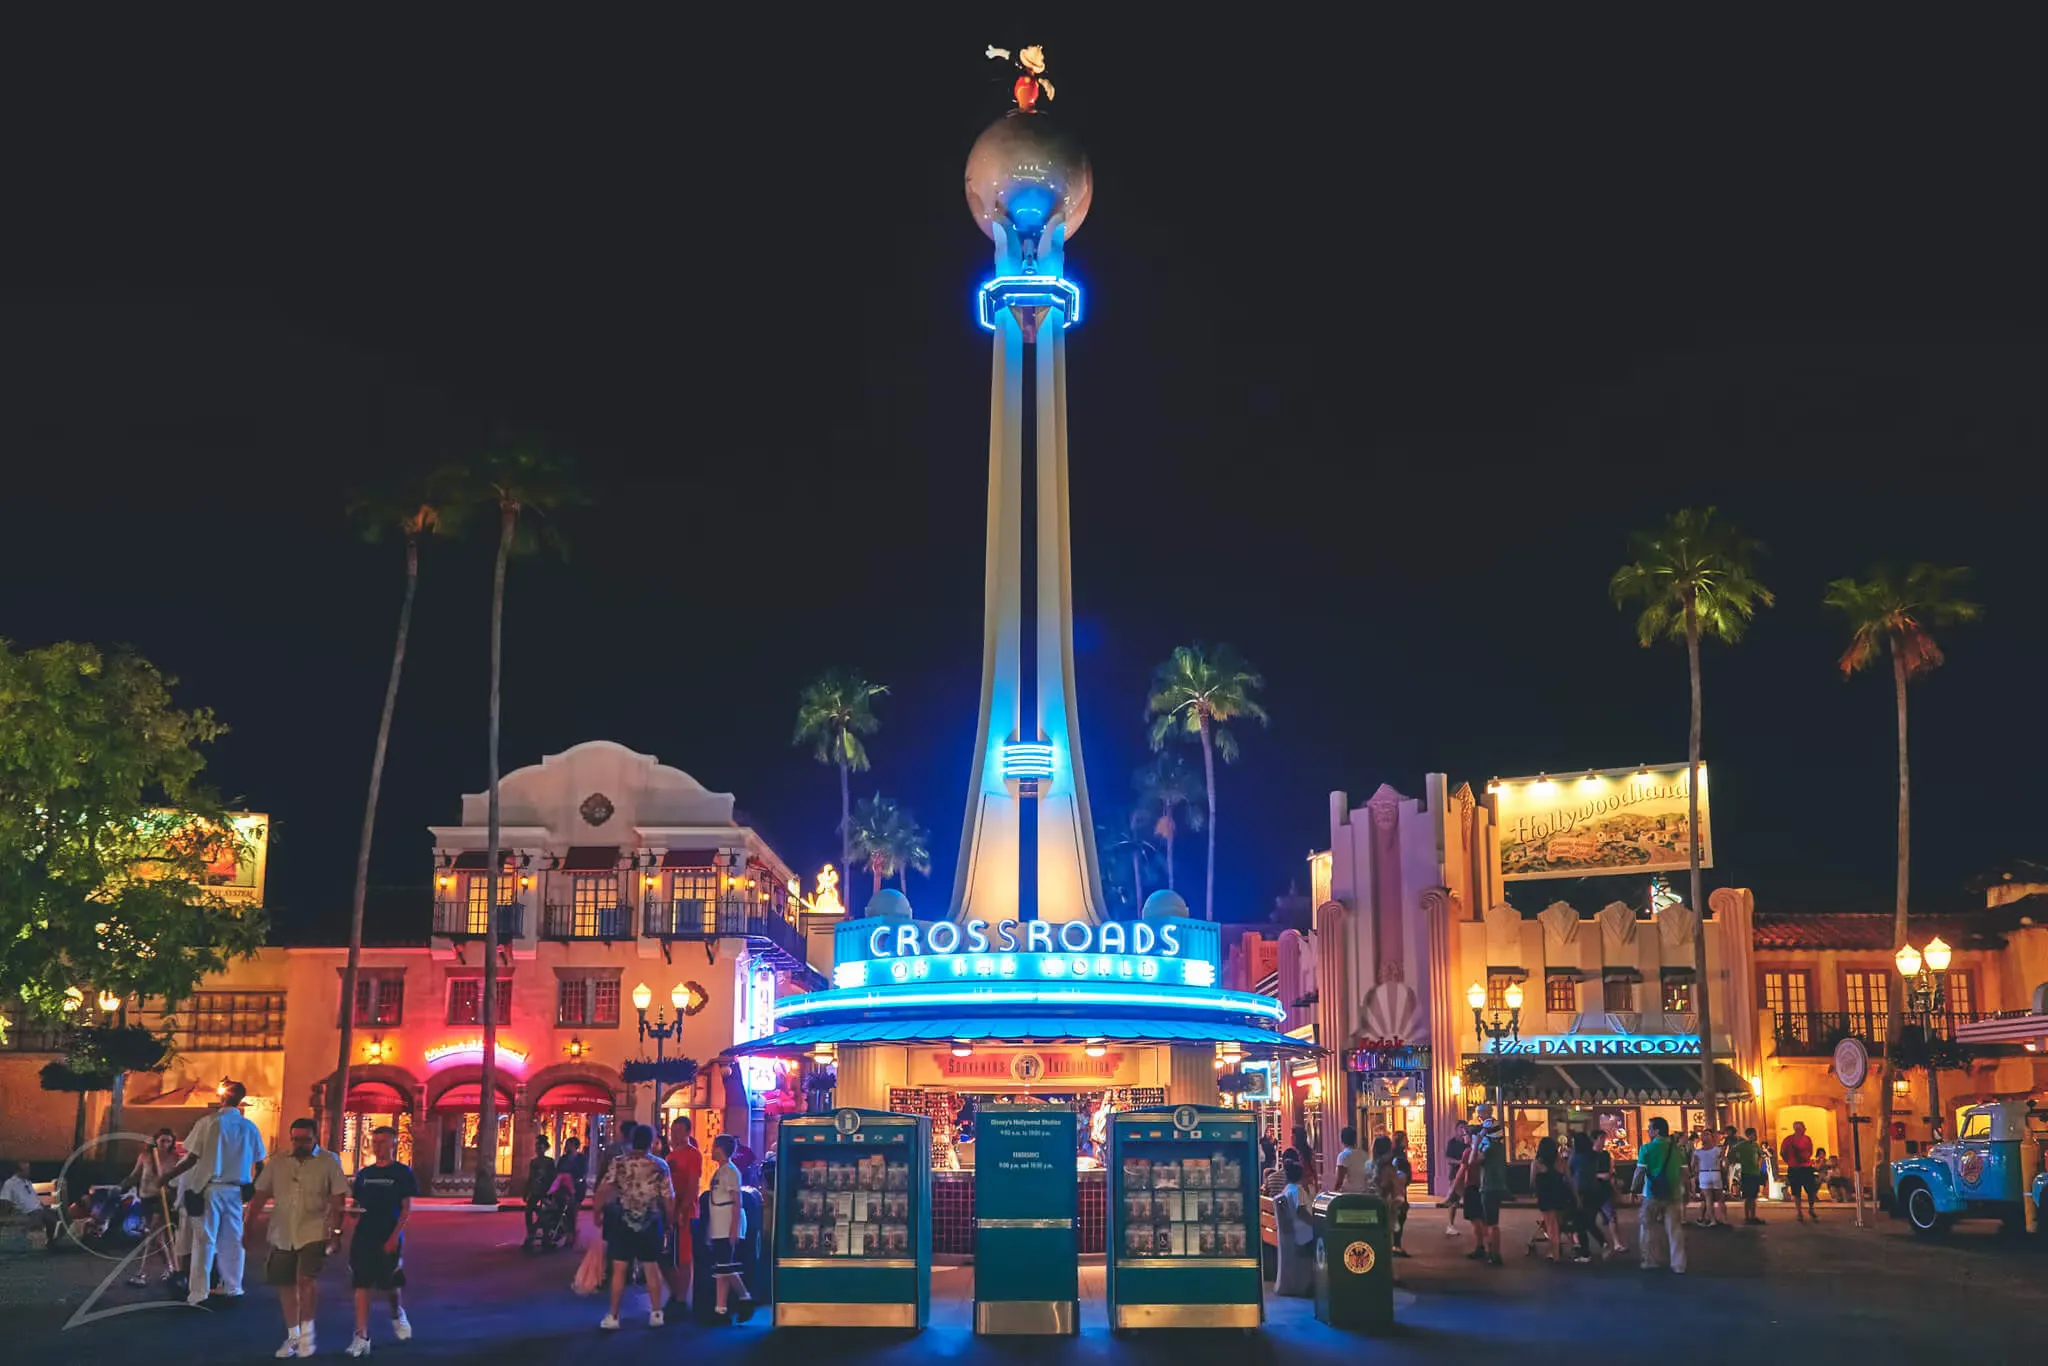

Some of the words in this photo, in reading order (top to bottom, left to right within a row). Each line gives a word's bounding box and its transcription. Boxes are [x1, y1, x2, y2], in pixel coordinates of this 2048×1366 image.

[1510, 779, 1689, 844] Hollywoodland
[870, 919, 1180, 957] CROSSROADS
[1493, 1039, 1535, 1055] The
[1538, 1039, 1701, 1054] DARKROOM
[1013, 1119, 1041, 1127] Hollywood
